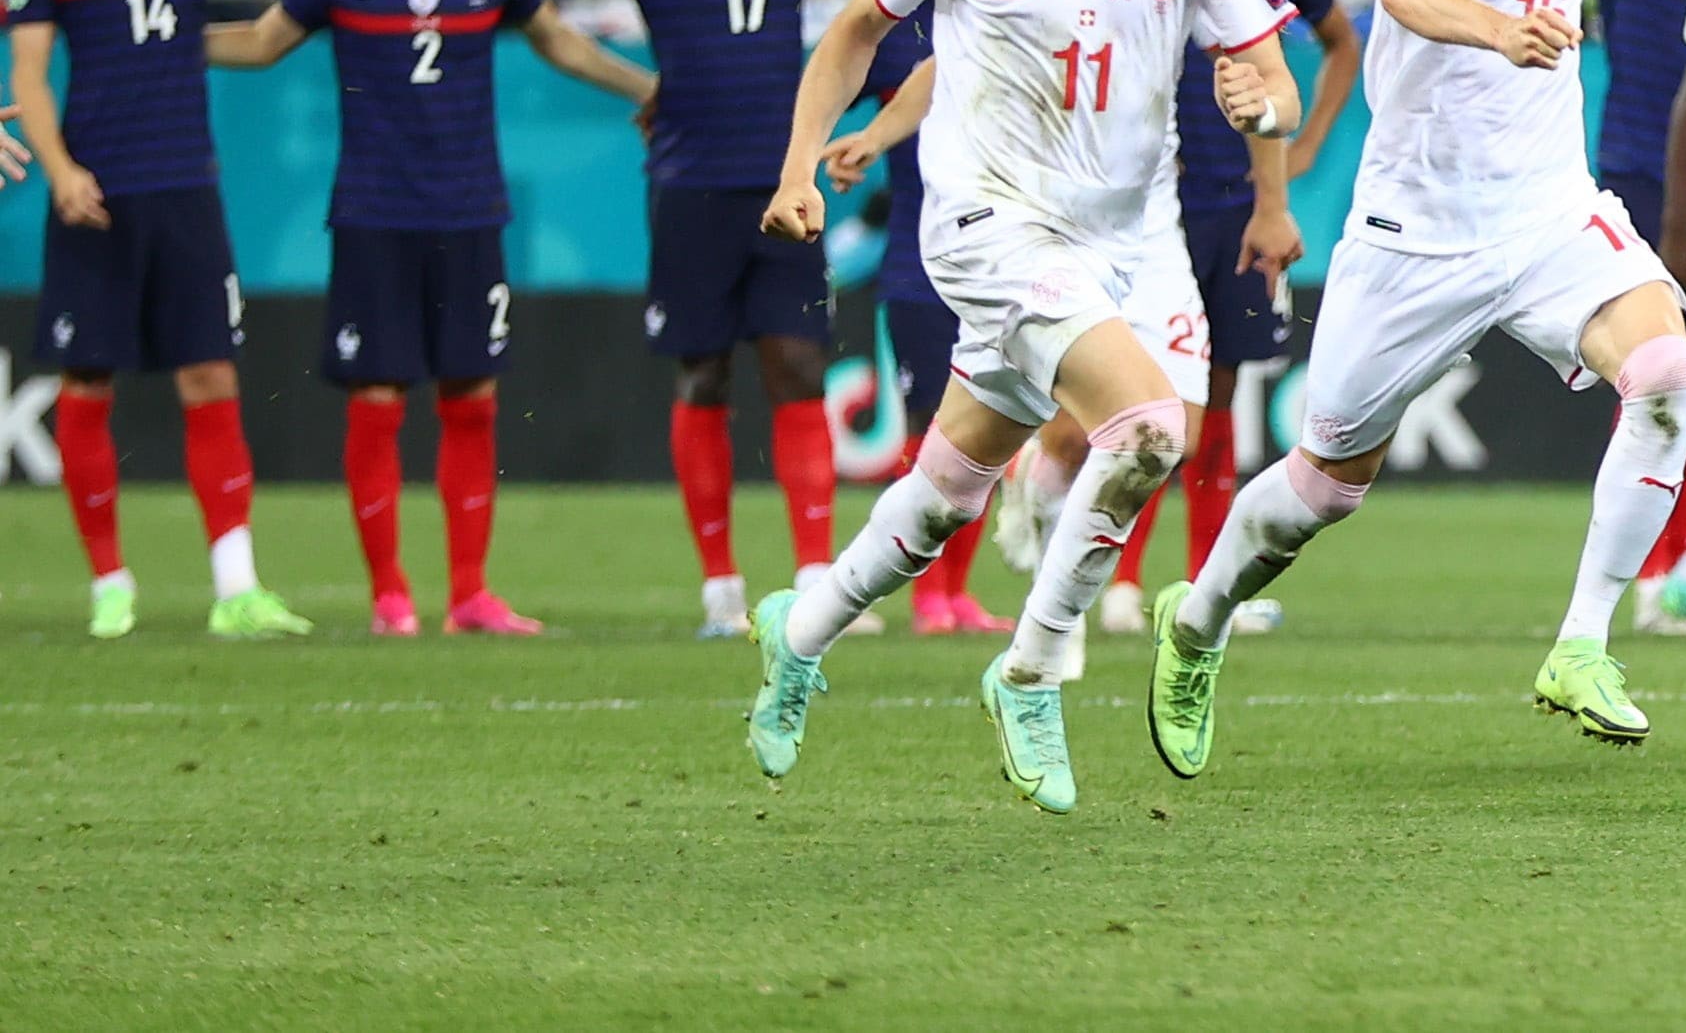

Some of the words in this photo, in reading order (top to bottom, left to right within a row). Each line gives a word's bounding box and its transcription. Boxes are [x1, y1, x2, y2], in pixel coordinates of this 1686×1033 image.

[410, 29, 443, 84] 2
[1052, 39, 1113, 112] 11
[487, 281, 511, 340] 2
